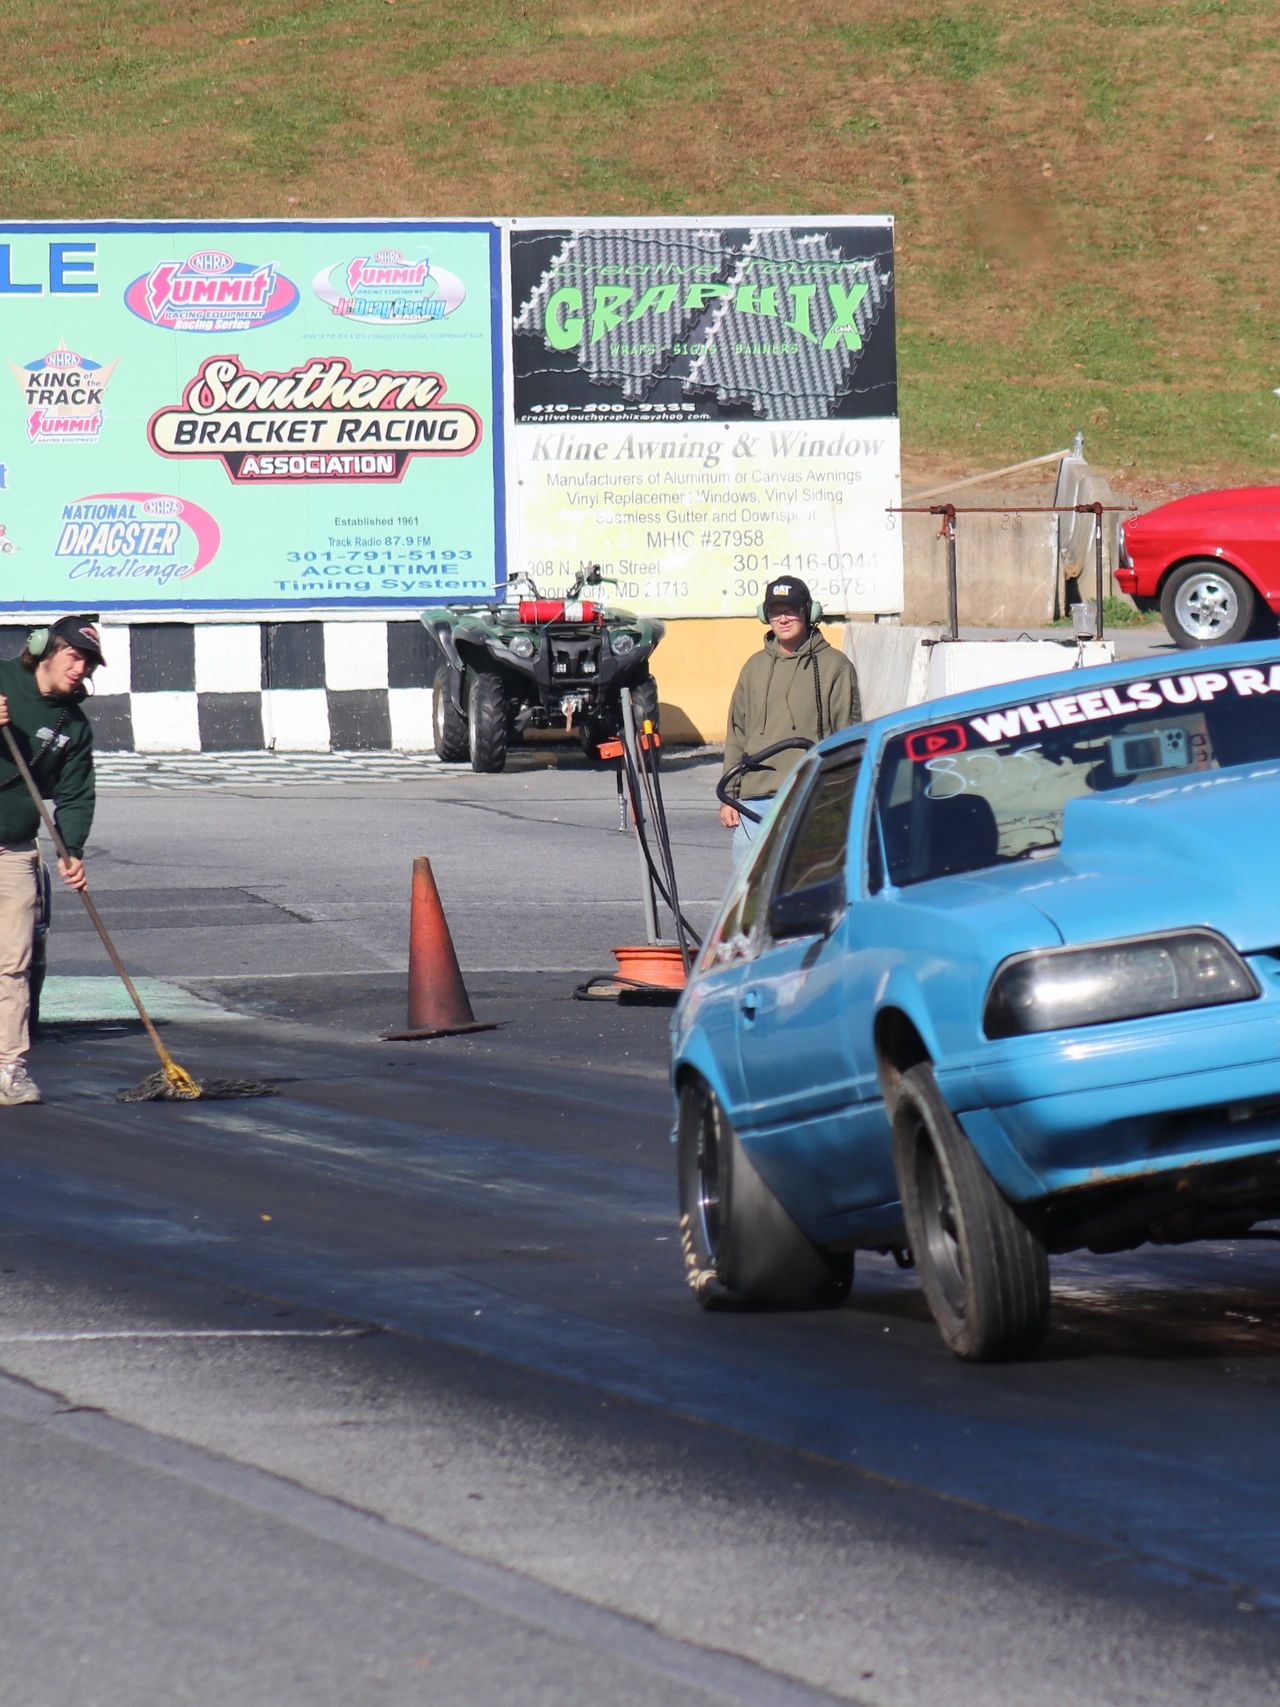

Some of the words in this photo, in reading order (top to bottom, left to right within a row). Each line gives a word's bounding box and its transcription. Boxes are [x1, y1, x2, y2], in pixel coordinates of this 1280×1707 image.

[193, 254, 228, 271] NHRA
[378, 251, 402, 263] NHRA
[553, 262, 720, 276] Creative
[165, 310, 203, 319] RACING
[206, 310, 265, 319] EQUIPMENT
[394, 297, 446, 320] Racing
[544, 282, 870, 351] GRAPHIX
[174, 319, 214, 331] Racing
[215, 319, 251, 330] Series
[609, 343, 656, 356] WRAPS
[673, 343, 718, 356] SIGNS
[734, 342, 799, 355] BANNERS
[48, 352, 80, 367] NHRA
[28, 372, 81, 388] KING
[86, 380, 102, 388] the
[187, 358, 442, 414] Southern
[25, 388, 104, 406] TRACK
[173, 418, 328, 445] BRACKET
[336, 418, 459, 444] RACING
[530, 431, 608, 462] Kline
[615, 431, 725, 469] Awning
[732, 434, 760, 459] &
[770, 430, 887, 459] Window
[241, 455, 393, 475] ASSOCIATION
[547, 471, 643, 487] Manufacturers
[647, 470, 661, 485] of
[664, 469, 730, 485] Aluminum
[734, 473, 748, 483] or
[751, 468, 803, 483] Canvas
[806, 468, 863, 484] Awnings
[566, 490, 600, 507] Vinyl
[765, 487, 798, 504] Vinyl
[802, 487, 844, 505] Siding
[62, 503, 138, 520] NATIONAL
[666, 509, 708, 524] Gutter
[711, 508, 737, 523] and
[334, 516, 394, 527] Established
[397, 516, 420, 526] 1961
[56, 521, 180, 557] DRAGSTER
[327, 536, 352, 548] Track
[354, 536, 382, 547] Radio
[384, 535, 414, 547] 87.9
[416, 535, 431, 547] FM
[645, 530, 696, 549] MHIC
[700, 530, 765, 548] #27958
[286, 550, 473, 563] 301-791-5193
[68, 558, 194, 586] Challenge
[301, 564, 459, 577] ACCUTIME
[527, 560, 554, 577] 308
[559, 560, 574, 577] N.
[579, 559, 614, 577] Min
[618, 558, 662, 577] Street
[274, 579, 371, 593] Timing
[380, 578, 488, 592] System
[615, 582, 639, 599] MD
[773, 584, 792, 596] CAT
